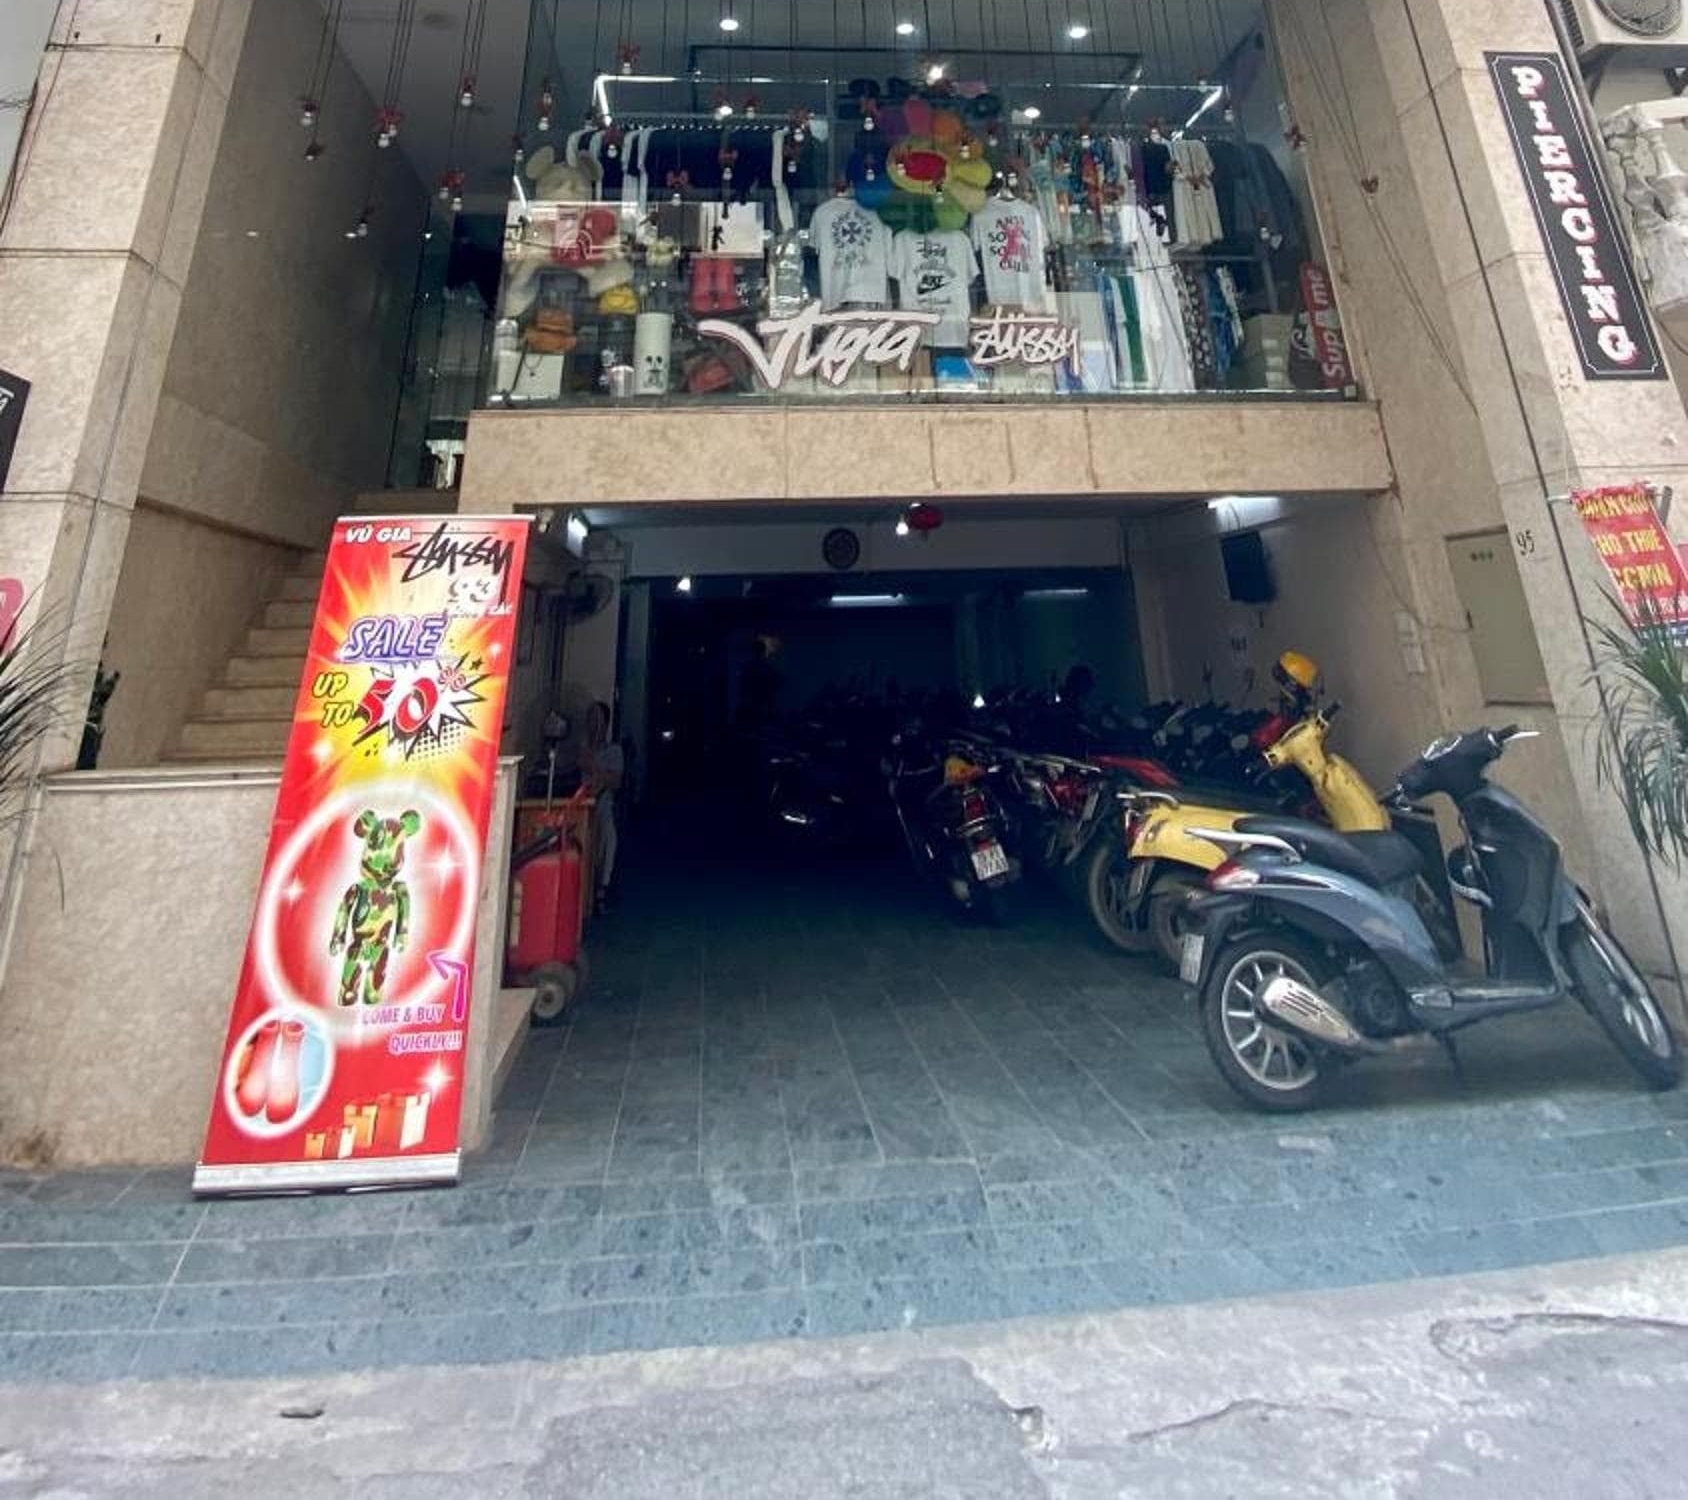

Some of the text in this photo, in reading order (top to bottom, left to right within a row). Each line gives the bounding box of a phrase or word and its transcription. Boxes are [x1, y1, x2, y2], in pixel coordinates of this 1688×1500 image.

[1511, 64, 1641, 367] PIERCING
[375, 527, 413, 543] GIA
[1592, 532, 1622, 557] HO
[342, 612, 448, 663] SALE
[312, 671, 348, 698] UP
[321, 701, 355, 729] TO
[416, 1004, 445, 1022] BUY
